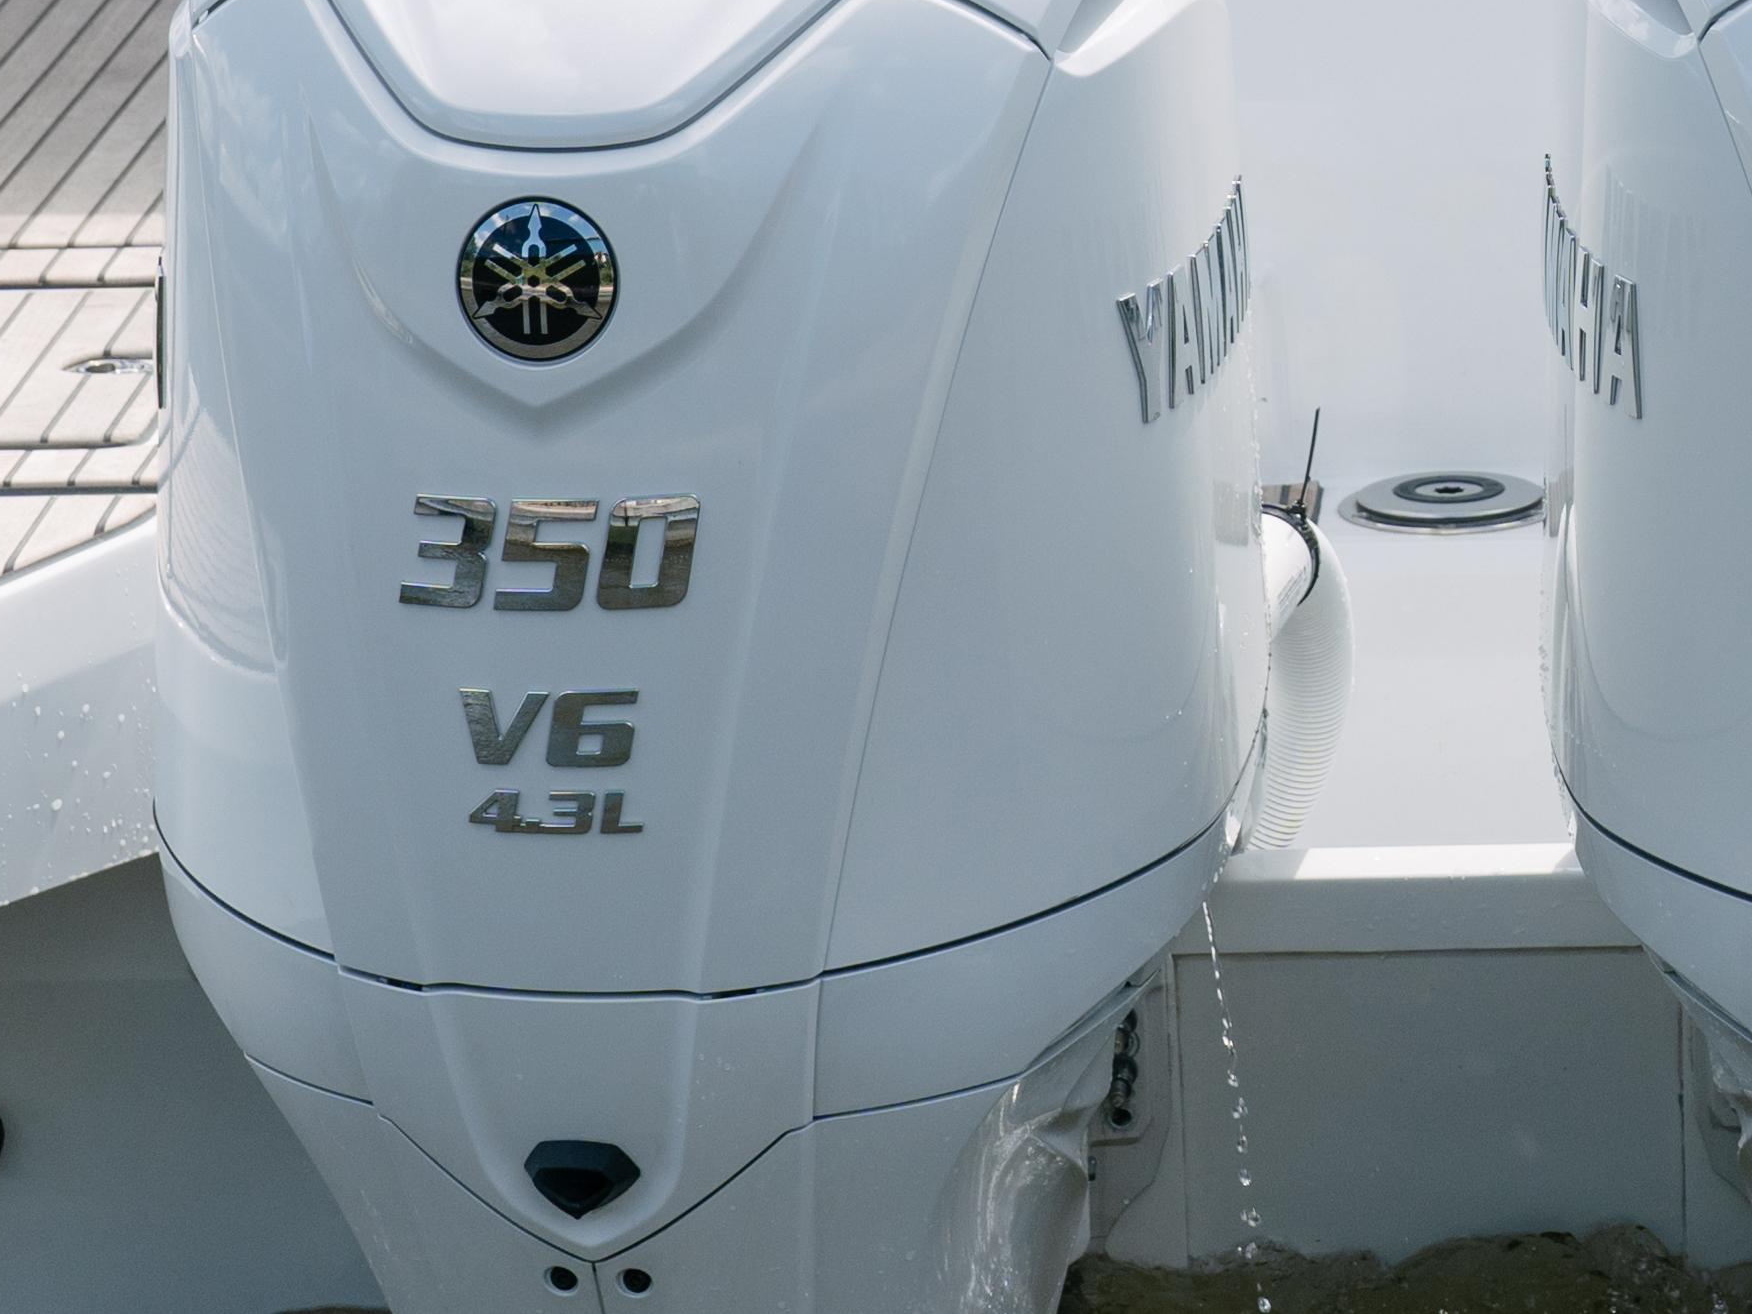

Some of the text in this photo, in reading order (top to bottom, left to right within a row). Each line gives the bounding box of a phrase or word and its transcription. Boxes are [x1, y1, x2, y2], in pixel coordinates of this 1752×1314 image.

[398, 492, 701, 612] 350
[458, 687, 640, 768] V6
[468, 787, 645, 835] 4.3L
